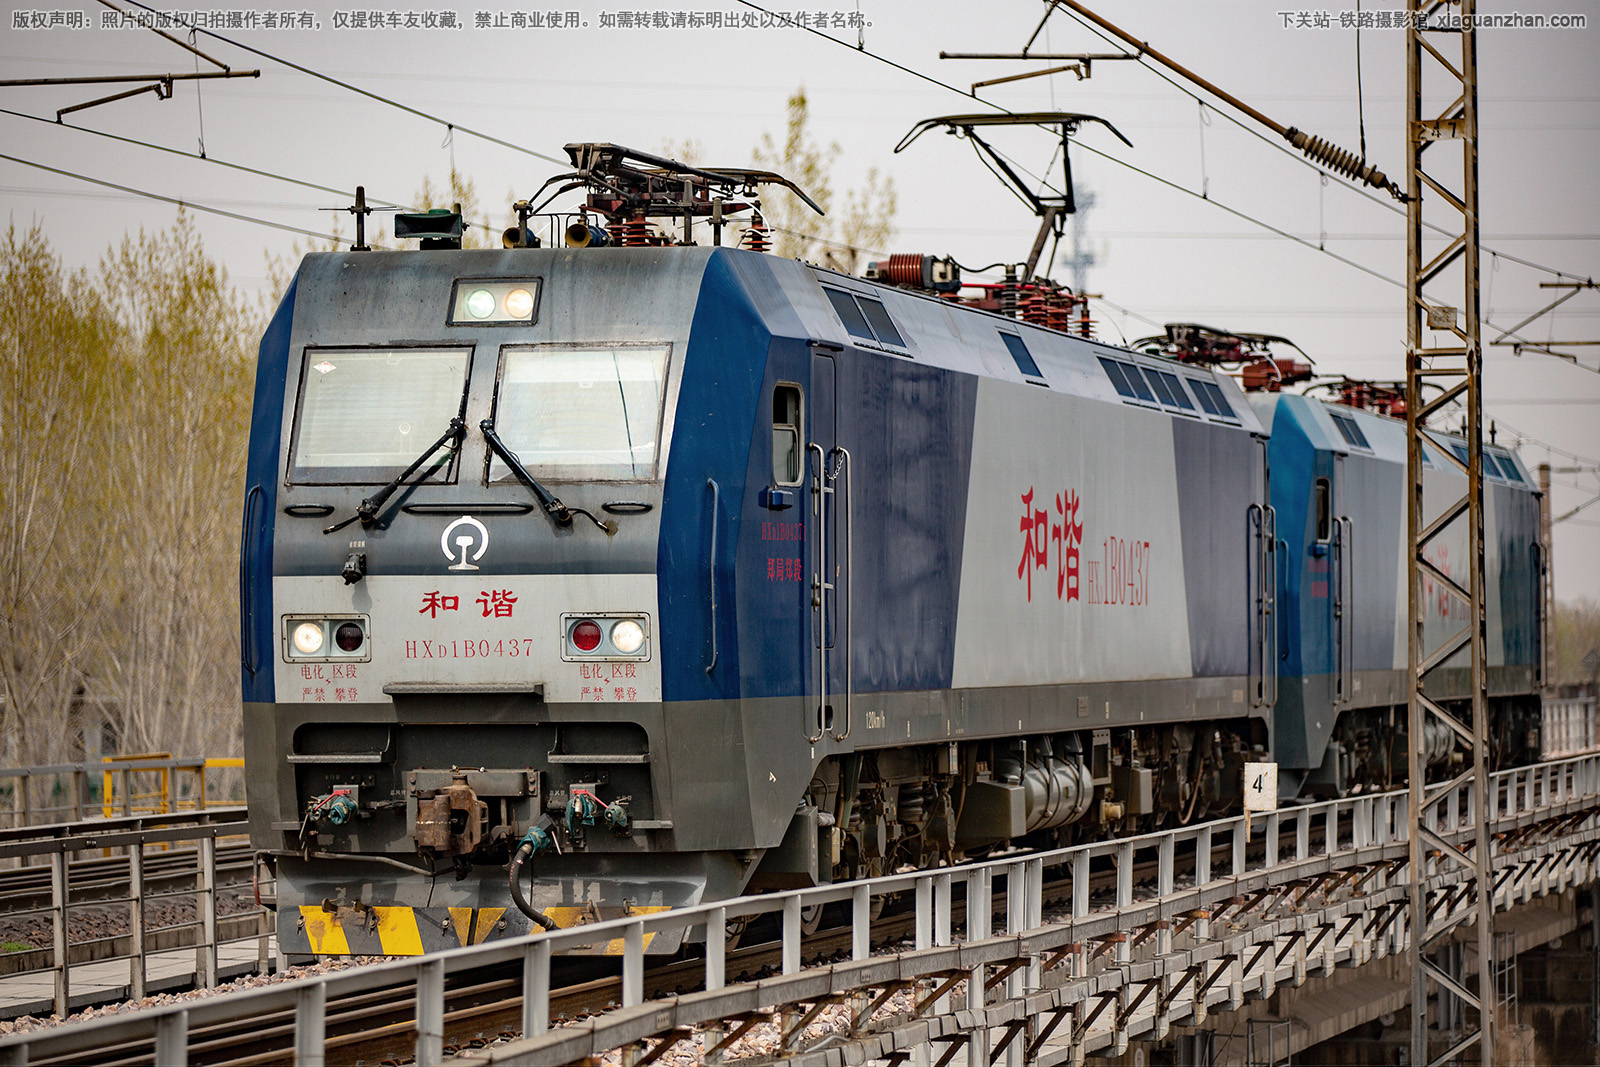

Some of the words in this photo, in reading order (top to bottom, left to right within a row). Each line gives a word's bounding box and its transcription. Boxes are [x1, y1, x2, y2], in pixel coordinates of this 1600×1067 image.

[1018, 485, 1083, 603] 和谐
[419, 589, 518, 619] 和谐
[405, 639, 533, 658] HXD1B0437
[301, 664, 325, 680] 电化
[333, 664, 357, 679] 区段
[580, 663, 603, 679] 电化
[612, 663, 636, 678] 区段
[302, 687, 325, 702] 严禁
[335, 687, 358, 702] 攀登
[580, 687, 604, 702] 严禁
[614, 687, 637, 702] 攀登
[1252, 774, 1263, 793] 4
